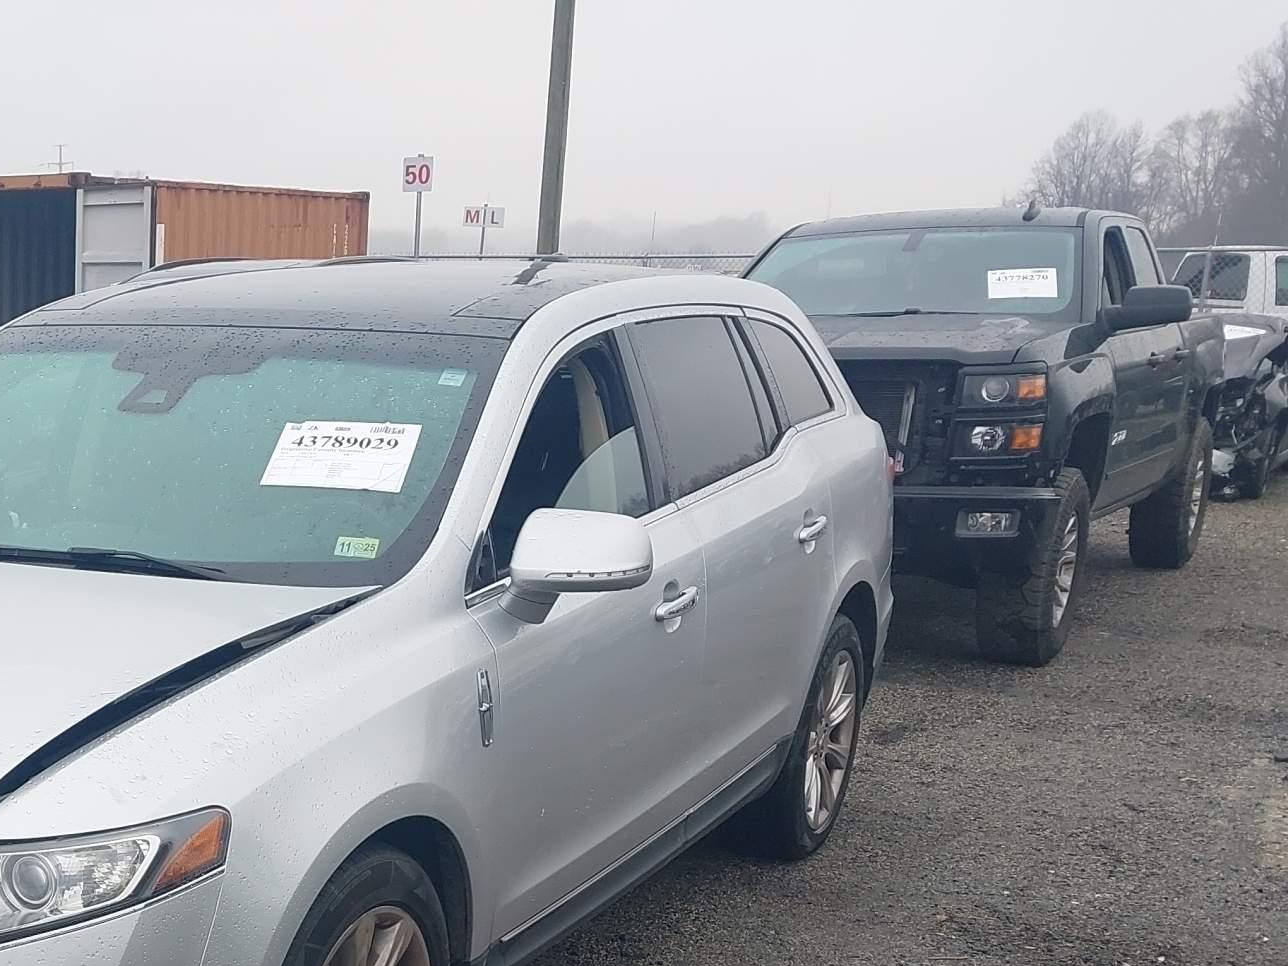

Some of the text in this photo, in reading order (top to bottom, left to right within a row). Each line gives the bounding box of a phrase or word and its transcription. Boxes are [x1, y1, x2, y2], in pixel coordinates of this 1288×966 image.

[405, 164, 430, 184] 50
[465, 209, 499, 224] M L
[291, 435, 399, 450] 43789029
[340, 542, 351, 552] 11
